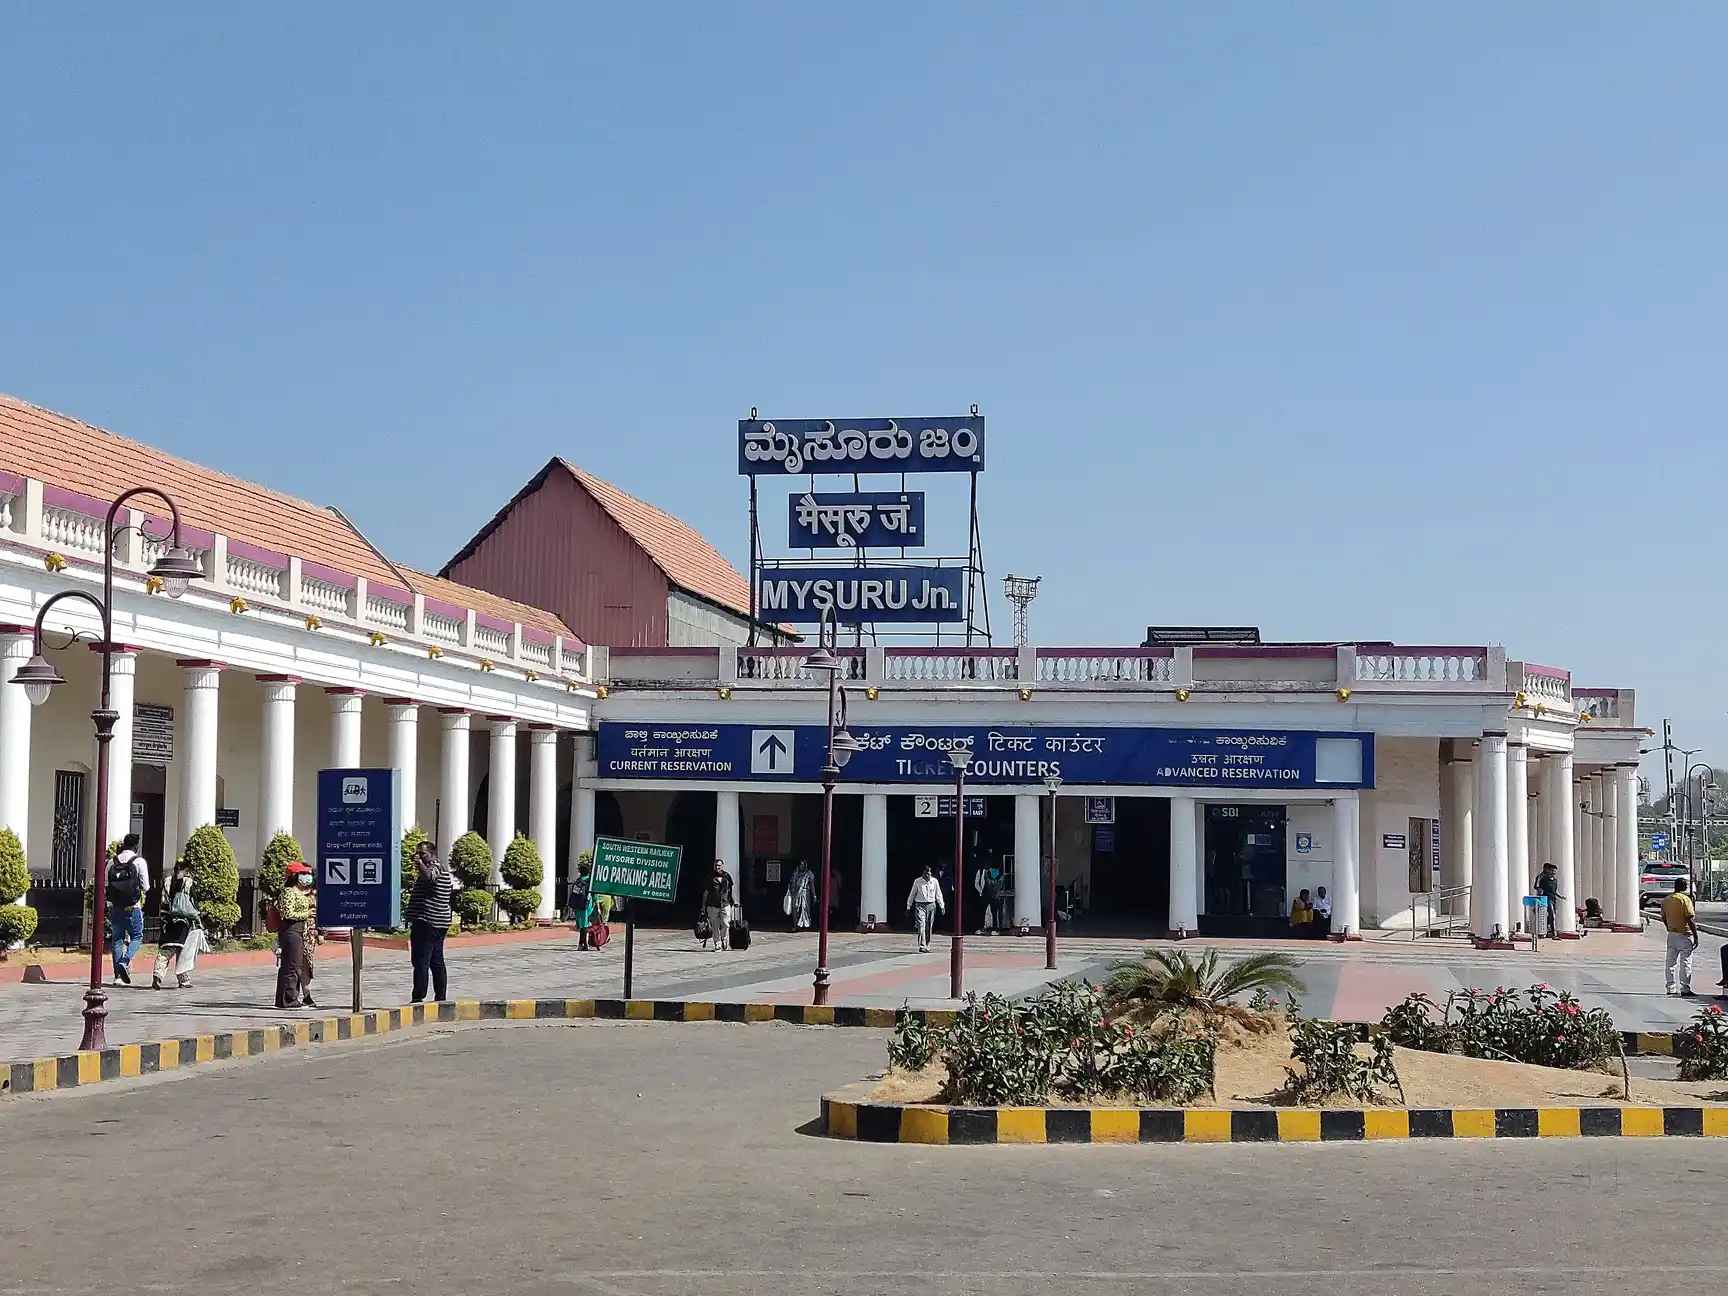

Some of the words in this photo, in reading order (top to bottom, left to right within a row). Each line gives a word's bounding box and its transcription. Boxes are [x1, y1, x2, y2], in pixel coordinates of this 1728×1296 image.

[744, 419, 913, 473] ಮೈಸೂರು
[795, 493, 873, 547] मैसूरु
[877, 495, 917, 534] जं.
[762, 580, 907, 610] MYSURU
[911, 579, 958, 610] Jn.
[988, 731, 1037, 752] टिकट
[1045, 732, 1106, 753] काउंटर
[631, 745, 669, 758] वर्तमान
[674, 747, 712, 758] आरक्षण
[610, 760, 658, 771] CURRENT
[660, 761, 732, 772] RESERVATION
[1223, 755, 1265, 765] आरक्षण
[963, 760, 1061, 777] COUNTERS
[1156, 767, 1218, 778] ADVANCED
[1221, 768, 1300, 779] RESERVATION
[920, 801, 931, 815] 2
[1222, 807, 1239, 817] SBI
[602, 842, 621, 852] SOUTH
[622, 845, 648, 855] WESTERN
[605, 854, 635, 864] MYSORE
[636, 858, 669, 868] DIVISION
[596, 865, 609, 882] NO
[610, 866, 648, 887] PARKING
[648, 872, 672, 890] AREA
